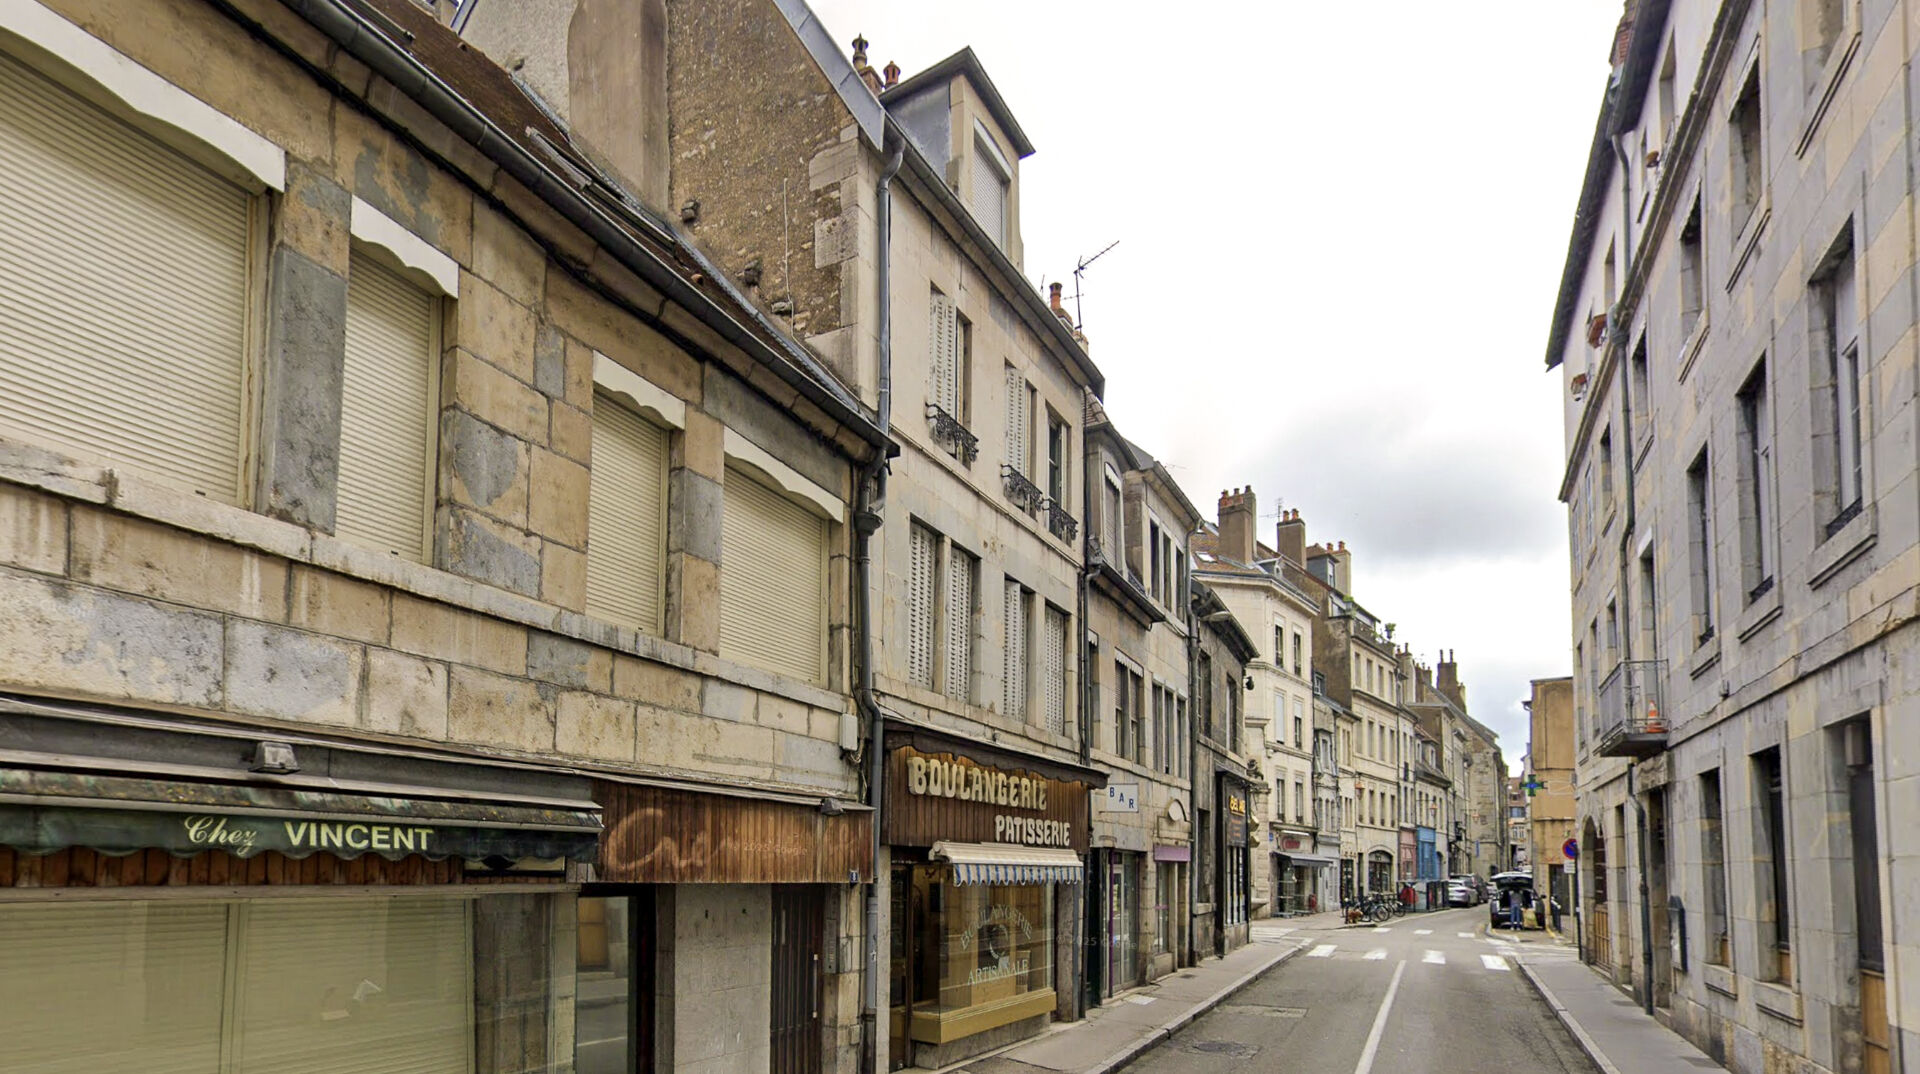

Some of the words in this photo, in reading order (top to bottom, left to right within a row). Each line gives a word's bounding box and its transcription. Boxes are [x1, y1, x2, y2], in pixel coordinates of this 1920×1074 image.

[907, 756, 1048, 811] BOULANGERIE
[1109, 786, 1135, 809] BAR
[184, 815, 257, 856] Chez
[284, 820, 435, 851] VINCENT
[995, 814, 1070, 847] PATISSERIE
[960, 904, 1033, 951] BOULANGERIE
[967, 959, 1029, 986] ARTISANALE
